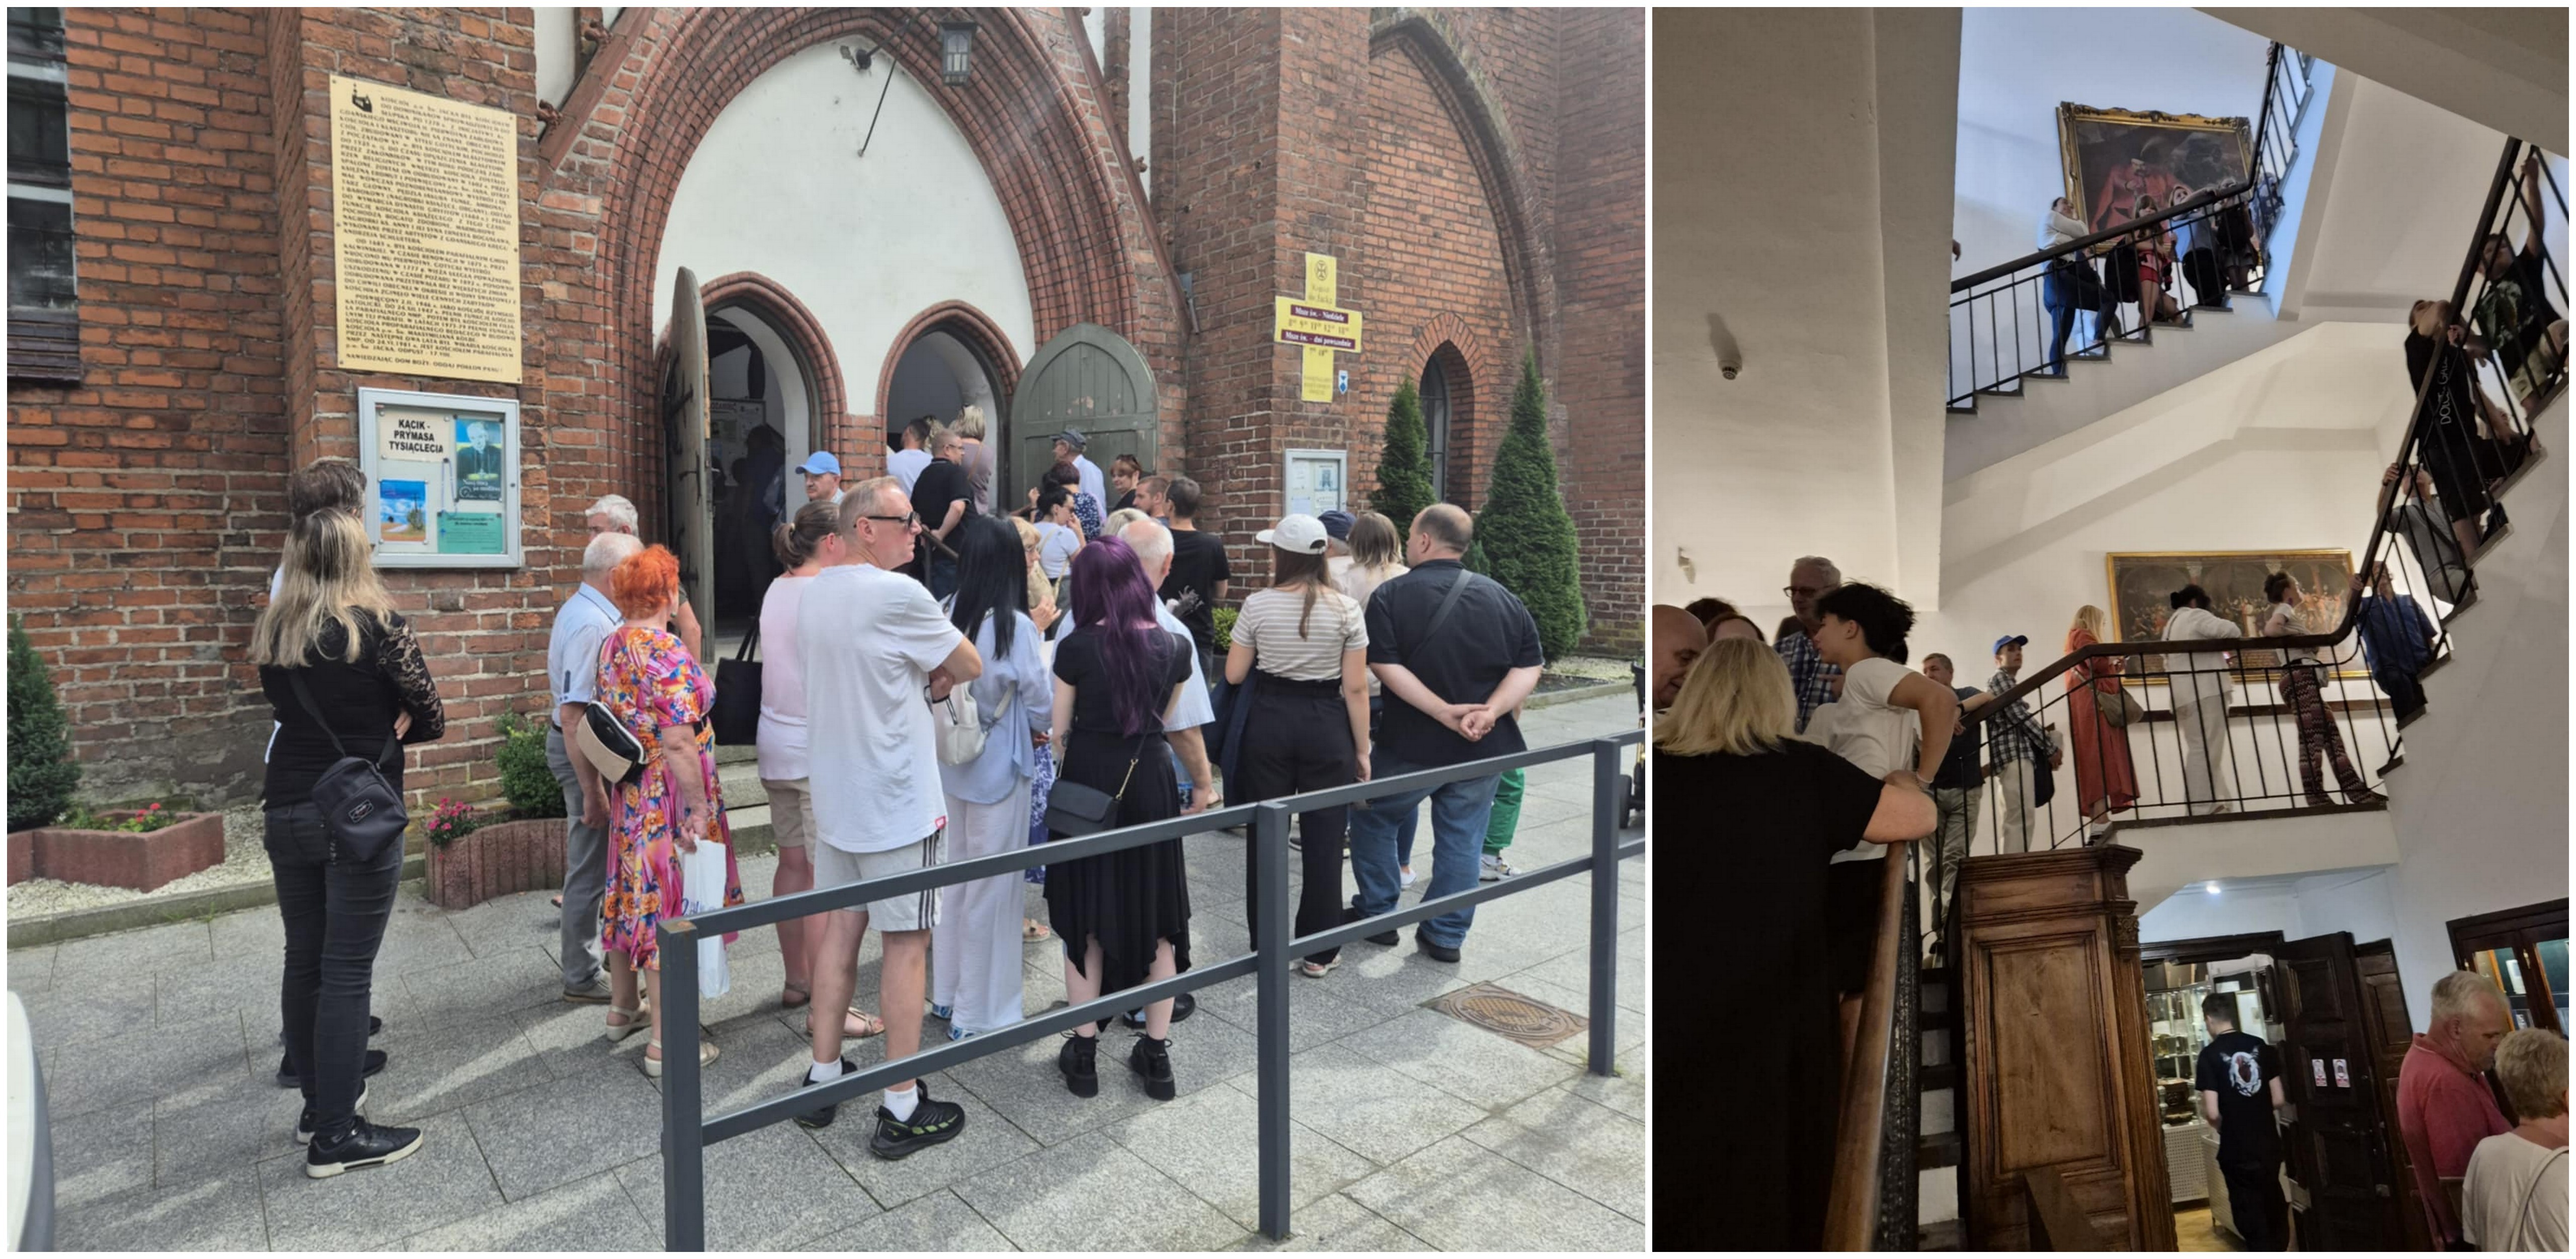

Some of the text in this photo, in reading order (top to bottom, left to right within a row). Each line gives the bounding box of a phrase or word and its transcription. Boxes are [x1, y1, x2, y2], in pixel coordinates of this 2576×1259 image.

[1295, 307, 1308, 316] Msze
[1322, 311, 1344, 321] Niedziele
[1285, 331, 1299, 340] Msze
[1324, 339, 1351, 347] powszednie
[398, 419, 425, 431] KĄCIK
[394, 430, 435, 442] PRYMASA
[389, 441, 444, 454] TYSIĄCLECIA
